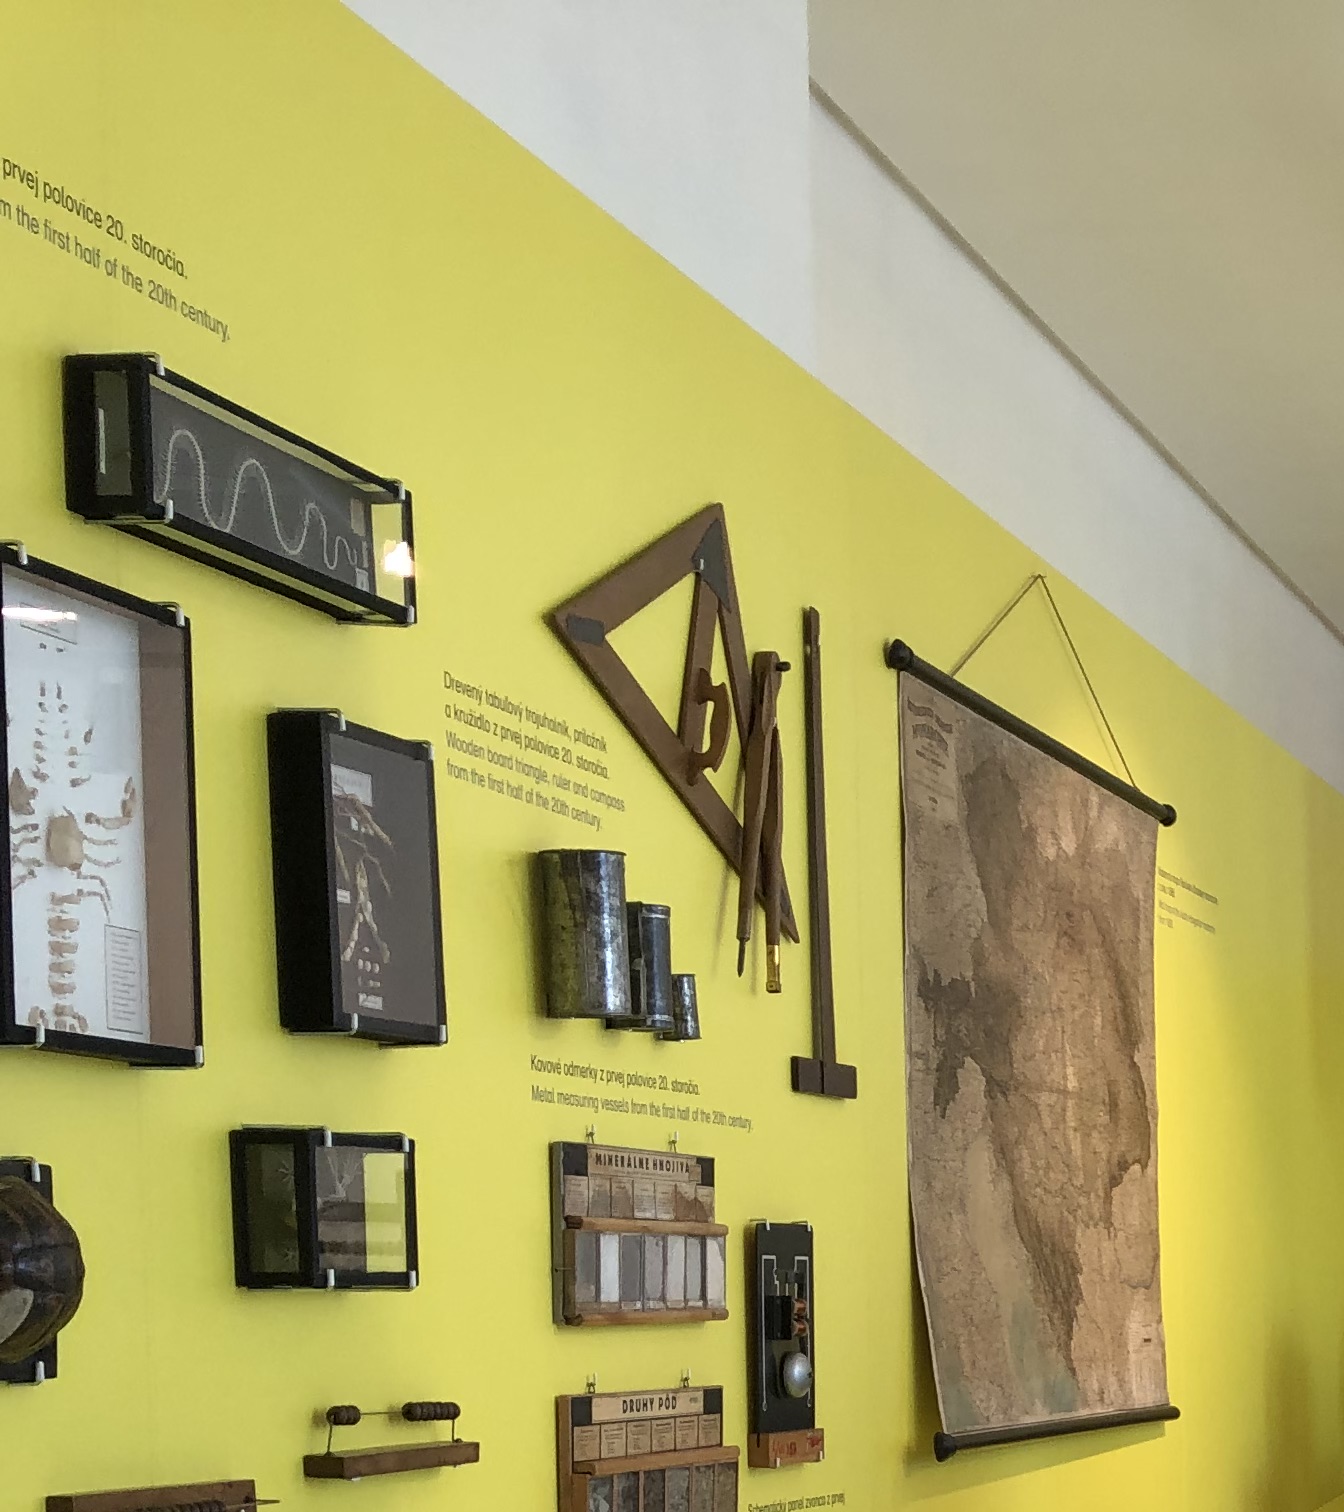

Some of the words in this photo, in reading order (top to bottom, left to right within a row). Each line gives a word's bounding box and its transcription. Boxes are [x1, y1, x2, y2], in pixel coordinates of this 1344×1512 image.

[1, 157, 38, 198] prvej
[43, 181, 102, 229] polovice
[105, 214, 127, 244] 20.
[131, 233, 187, 279] storočia.
[16, 204, 39, 234] the
[42, 218, 70, 253] first
[74, 235, 100, 269] half
[104, 257, 117, 279] of
[121, 264, 143, 293] the
[148, 279, 177, 311] 20th
[180, 300, 230, 343] century.
[622, 1397, 654, 1414] DRUHY
[658, 1394, 677, 1410] PÔD
